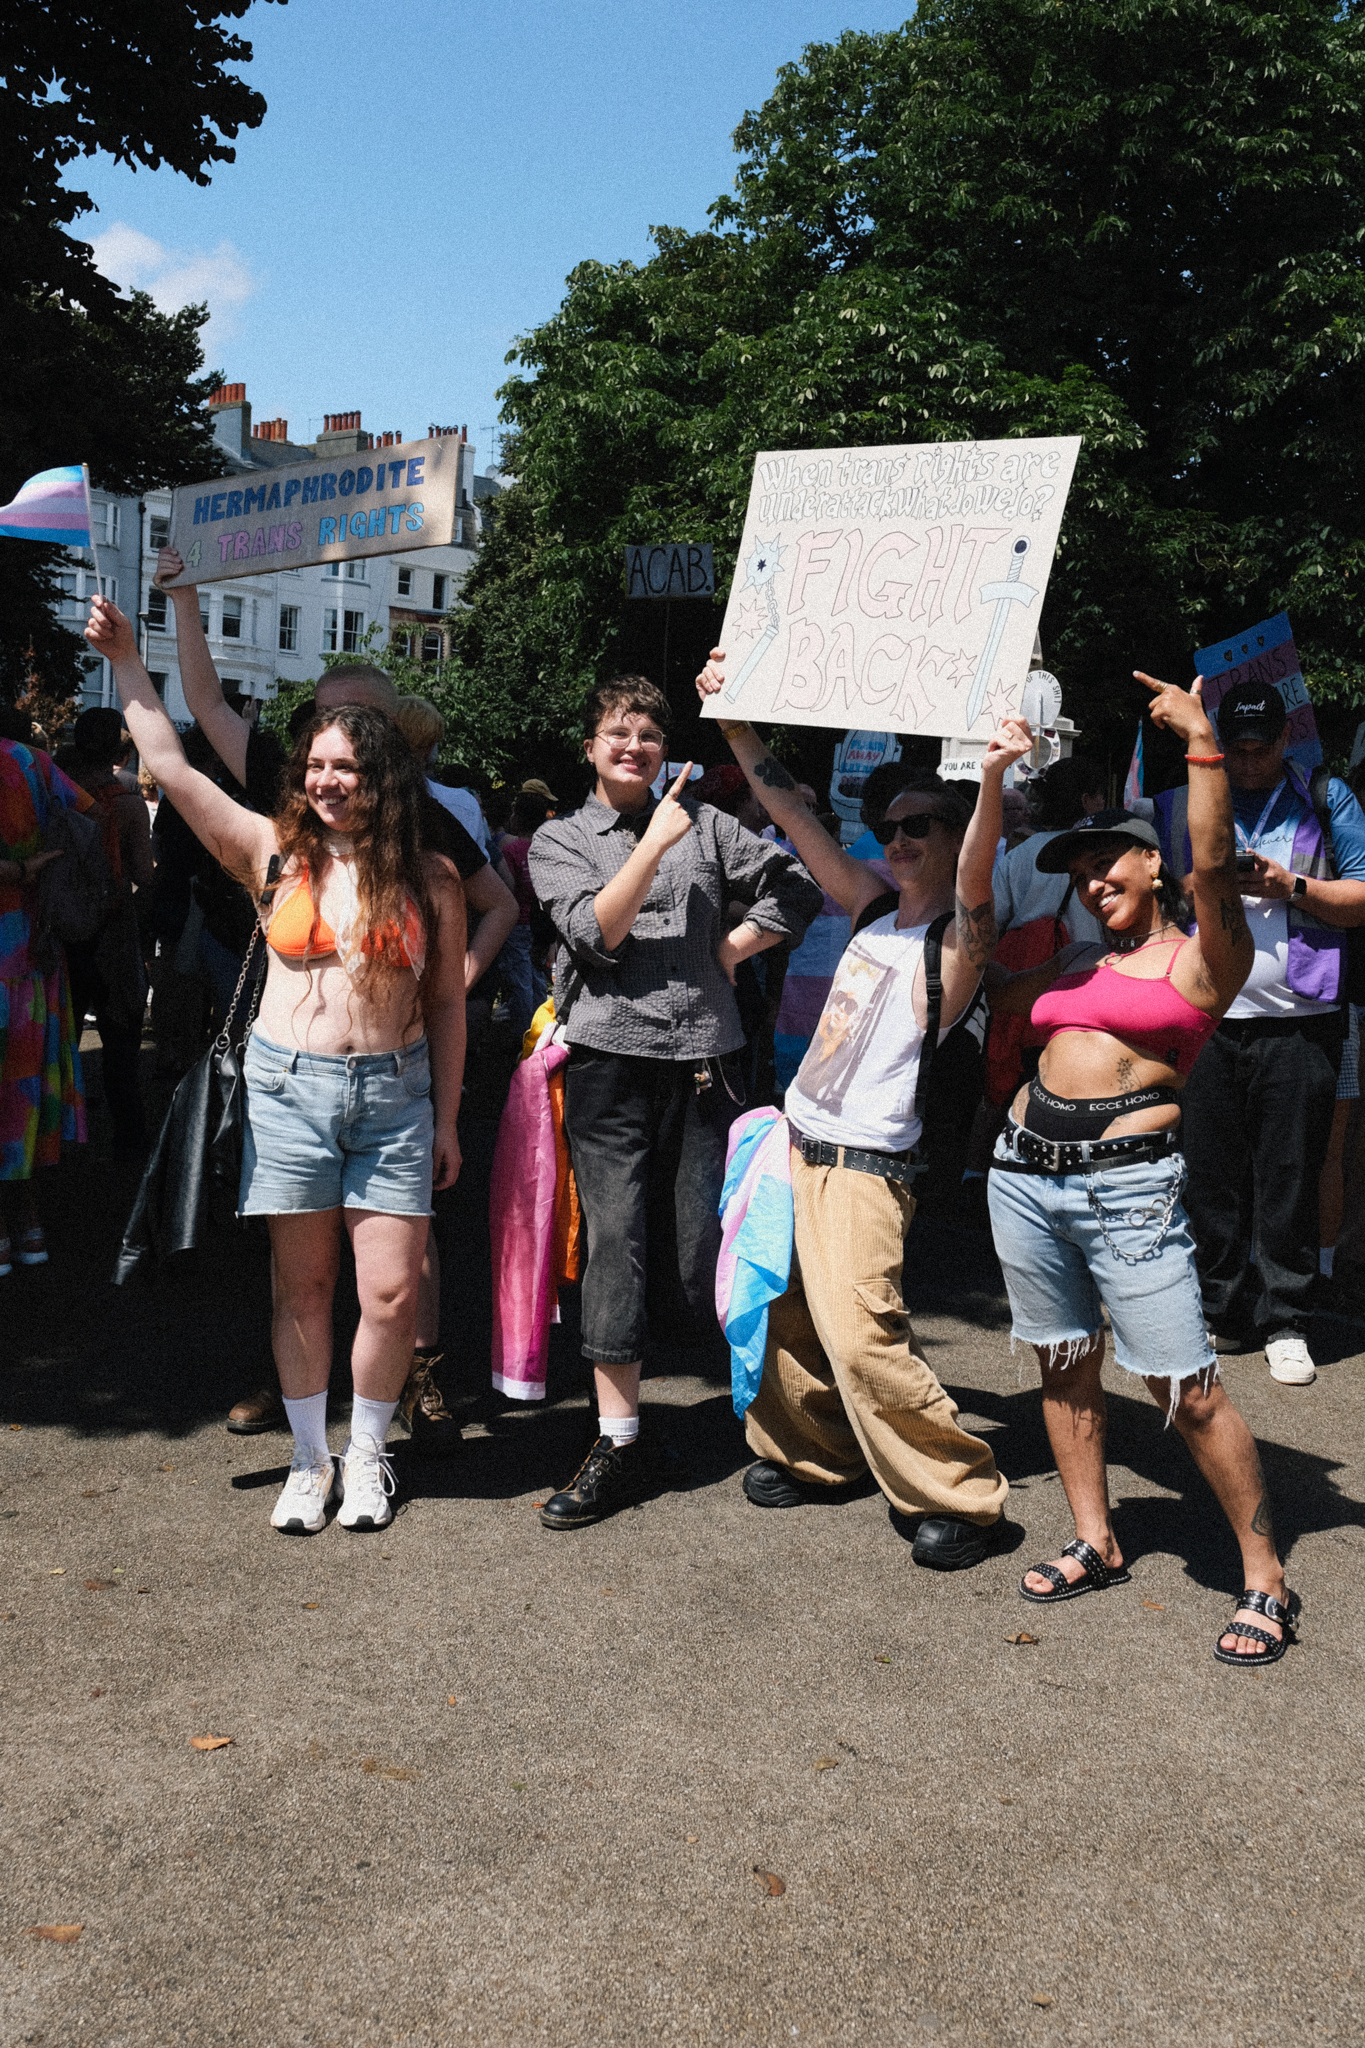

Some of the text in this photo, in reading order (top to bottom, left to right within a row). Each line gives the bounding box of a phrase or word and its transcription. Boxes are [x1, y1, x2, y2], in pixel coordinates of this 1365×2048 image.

[193, 457, 425, 525] HERMAPHRODITE
[759, 443, 1061, 491] When trans rights are
[1002, 481, 1055, 522] do?
[186, 502, 425, 568] 4 TRANS RIGHTS
[787, 524, 1012, 627] FIGHT
[771, 618, 955, 729] BACK
[1038, 671, 1055, 684] THIS
[1052, 685, 1061, 704] SHIT
[1207, 648, 1288, 700] TRANS
[944, 762, 958, 771] YOU
[960, 761, 976, 771] ARE
[1033, 1085, 1077, 1112] ECCE HOMO
[1089, 1100, 1123, 1111] ECCE
[1125, 1092, 1160, 1106] HOMO
